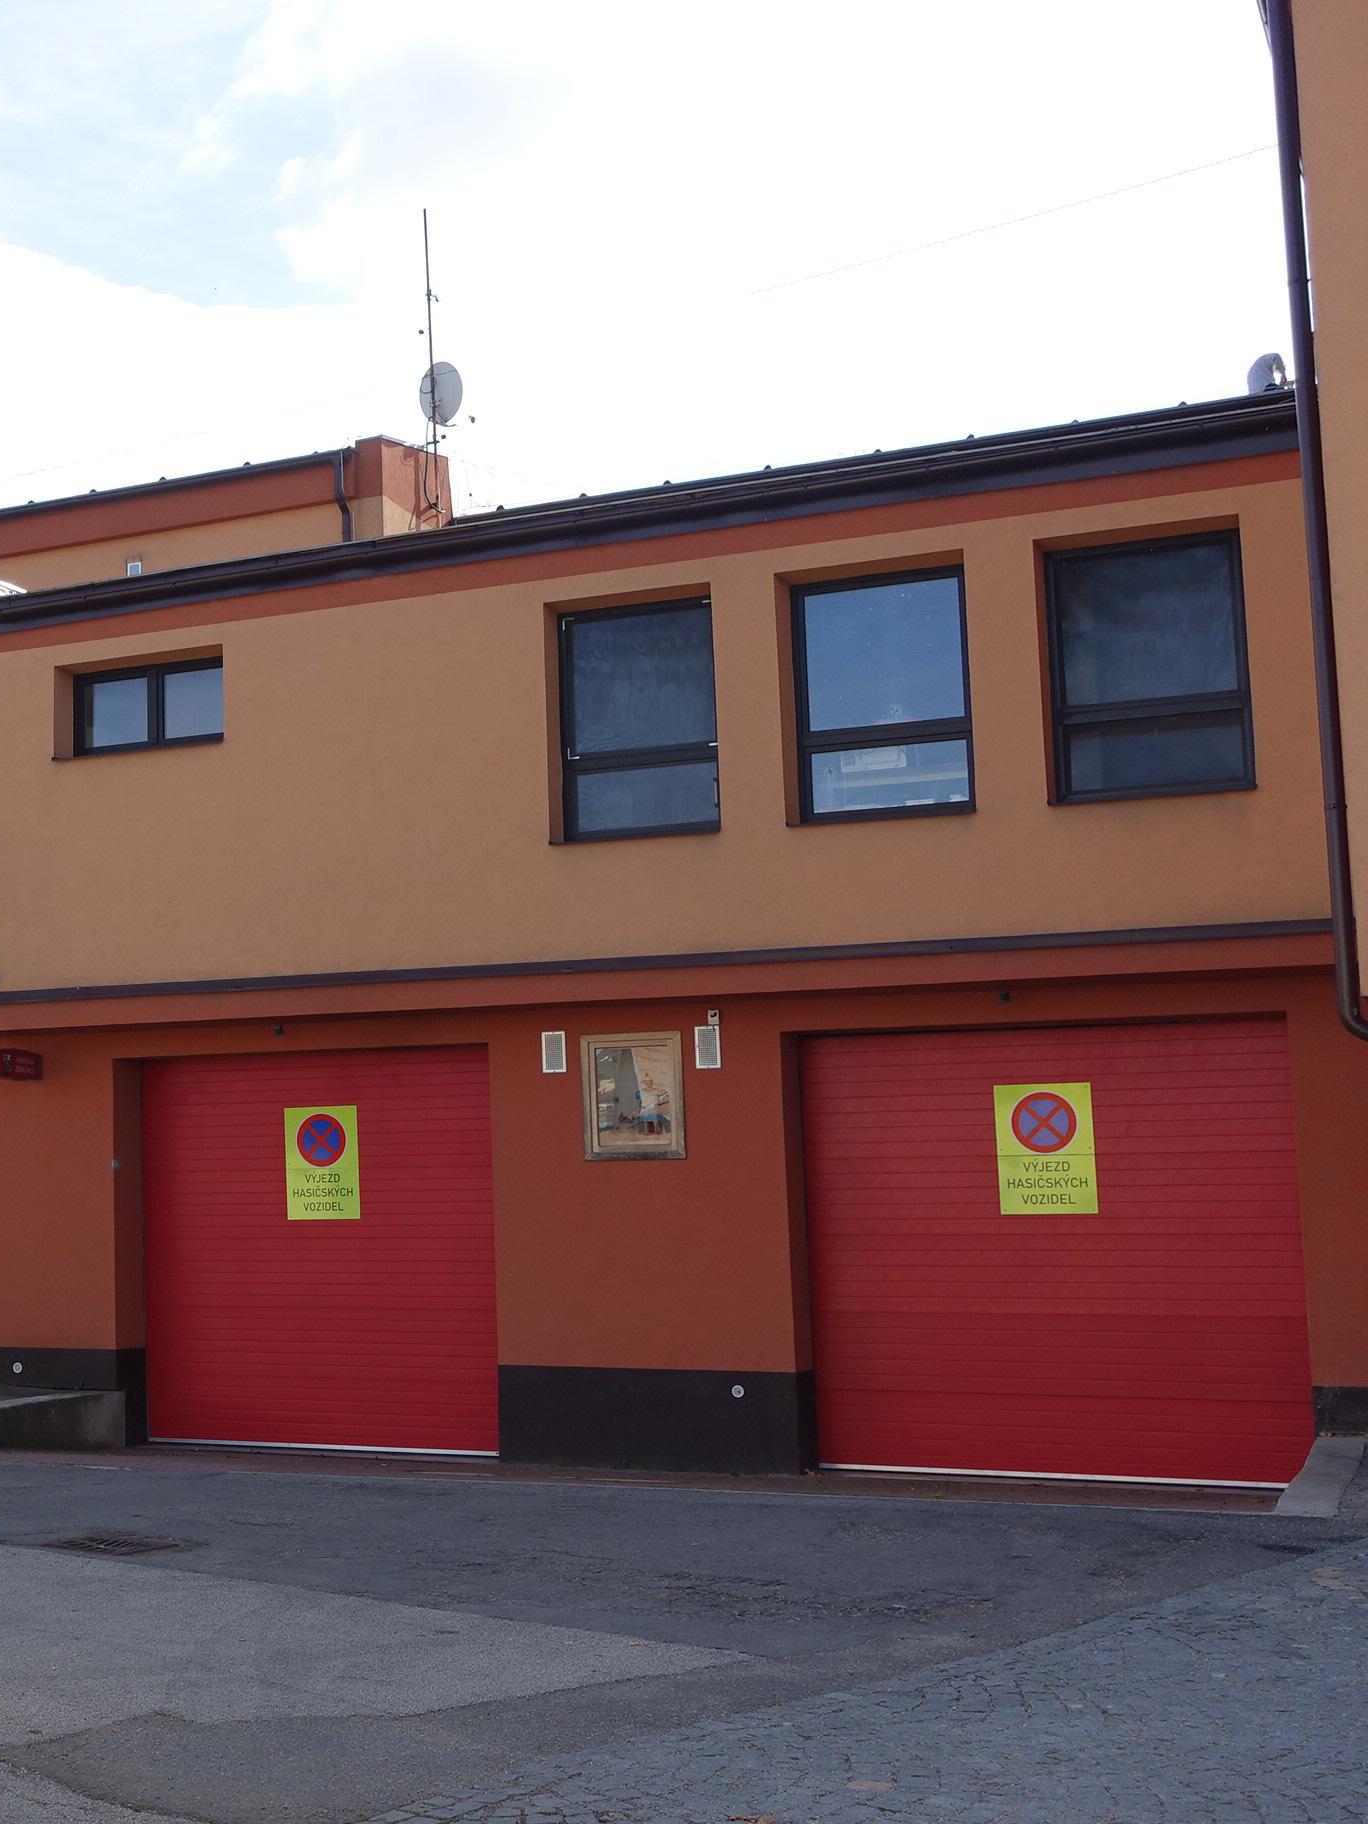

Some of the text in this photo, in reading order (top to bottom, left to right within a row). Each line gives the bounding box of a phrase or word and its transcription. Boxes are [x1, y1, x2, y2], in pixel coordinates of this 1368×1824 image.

[1023, 1159, 1070, 1172] VÝJEZD
[304, 1171, 341, 1183] VÝJEZD
[1007, 1174, 1089, 1189] HASIČSKÝCH
[292, 1185, 354, 1198] HASIČSKÝCH
[1022, 1194, 1077, 1205] VOZIDEL
[303, 1202, 344, 1212] VOZIDEL
